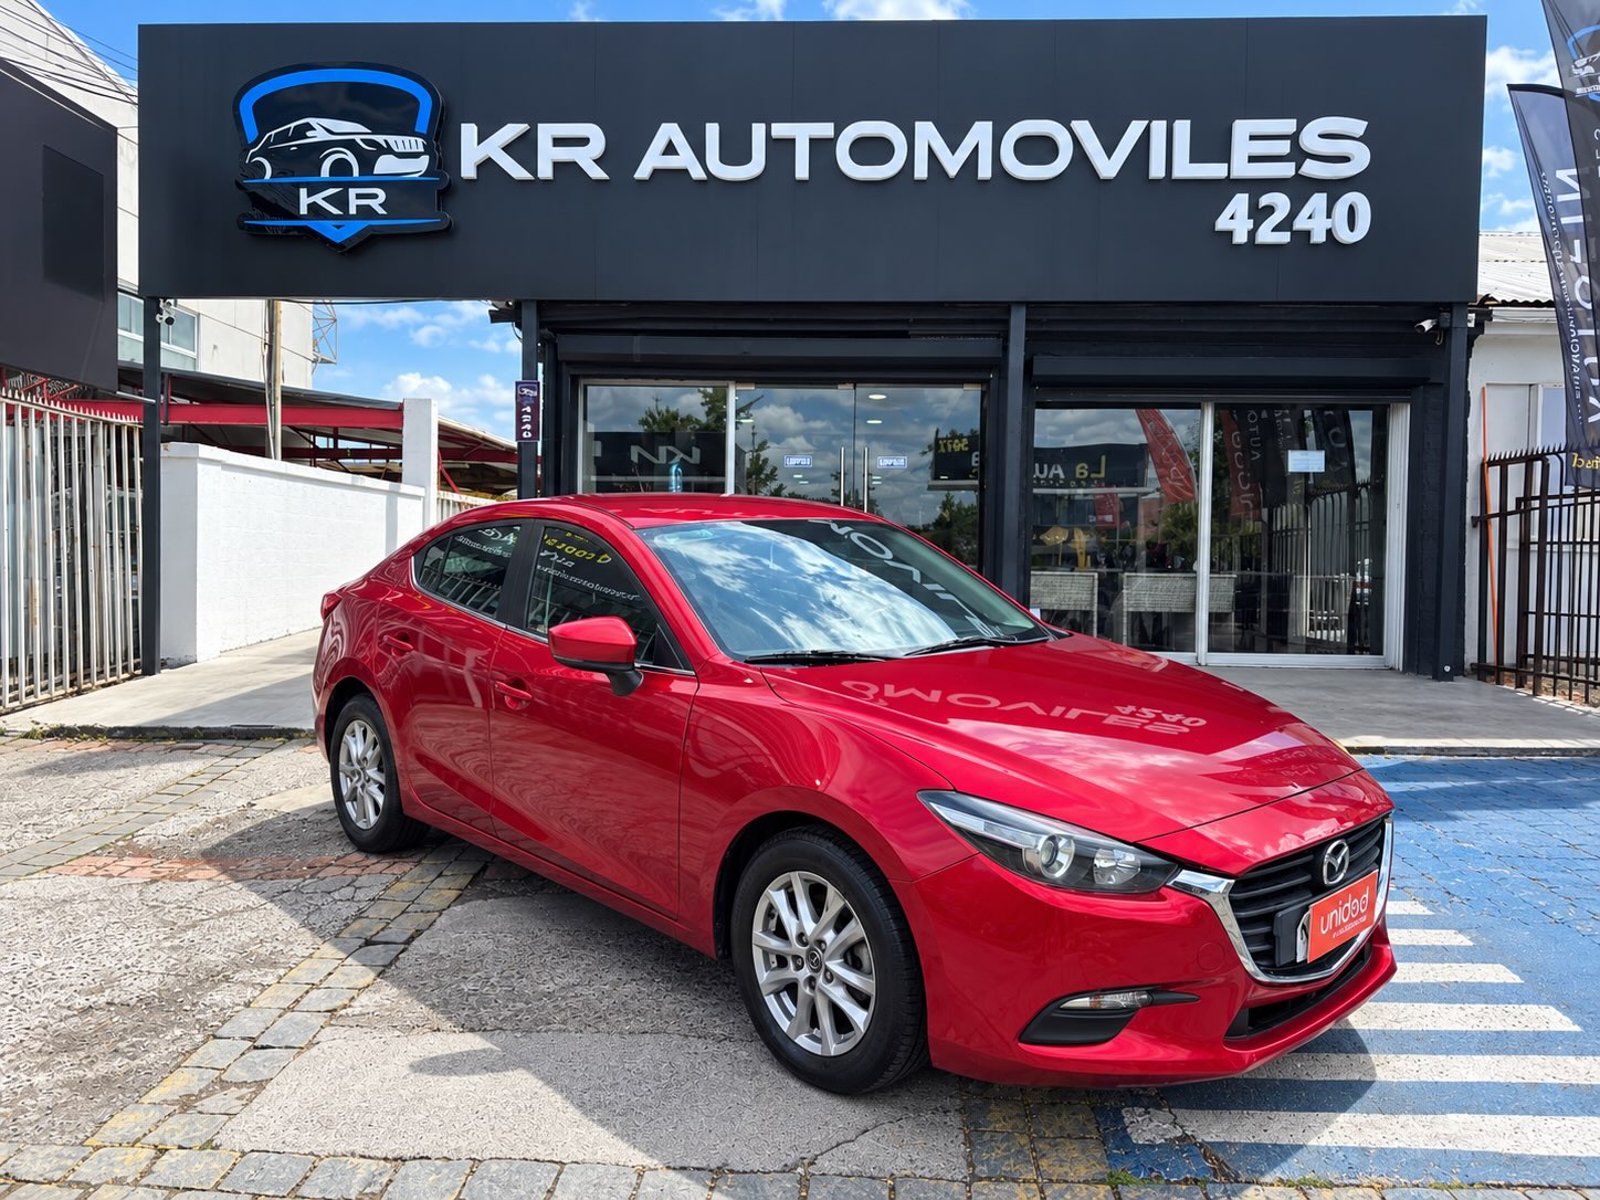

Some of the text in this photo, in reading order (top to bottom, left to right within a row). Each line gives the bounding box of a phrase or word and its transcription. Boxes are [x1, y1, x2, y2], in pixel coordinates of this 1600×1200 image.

[460, 116, 1371, 182] KR AUTOMOVILES
[299, 187, 388, 215] KR
[1214, 191, 1372, 245] 4240
